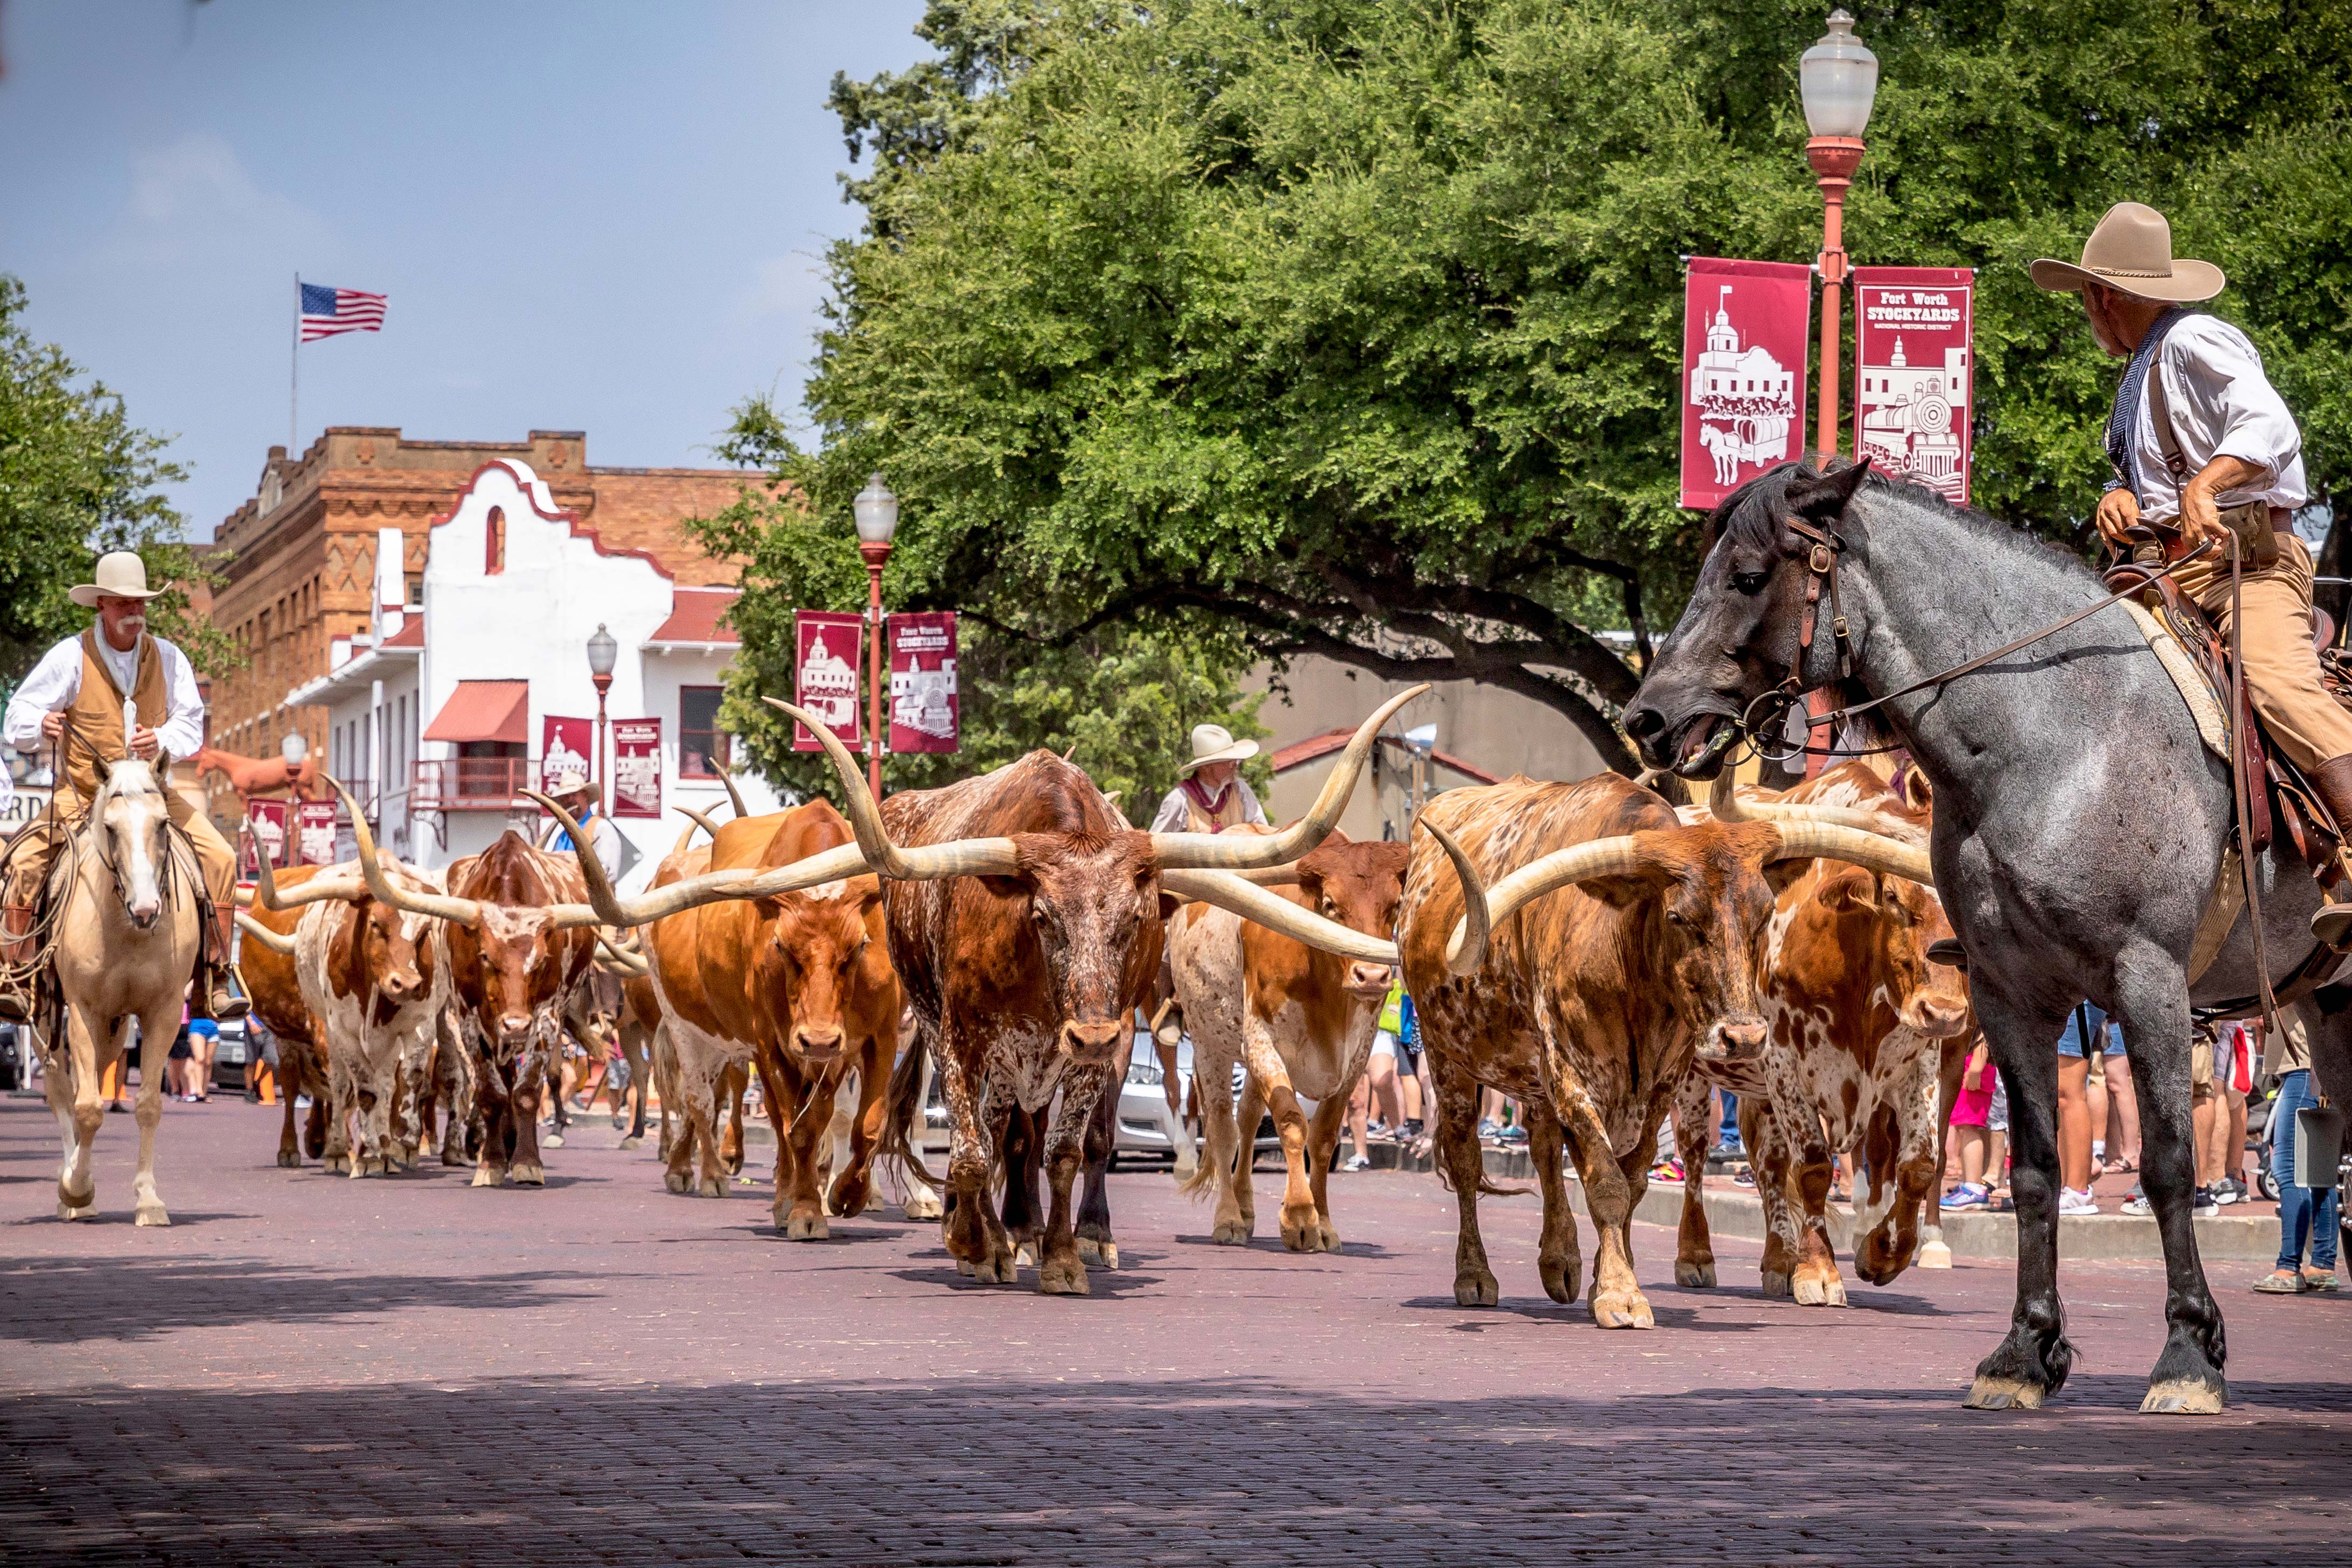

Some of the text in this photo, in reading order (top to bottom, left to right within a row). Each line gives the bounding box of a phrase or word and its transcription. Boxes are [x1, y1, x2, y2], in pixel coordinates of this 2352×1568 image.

[1881, 292, 1948, 306] Fort Worth
[1867, 307, 1960, 321] STOCKYARDS
[0, 796, 43, 821] RD
